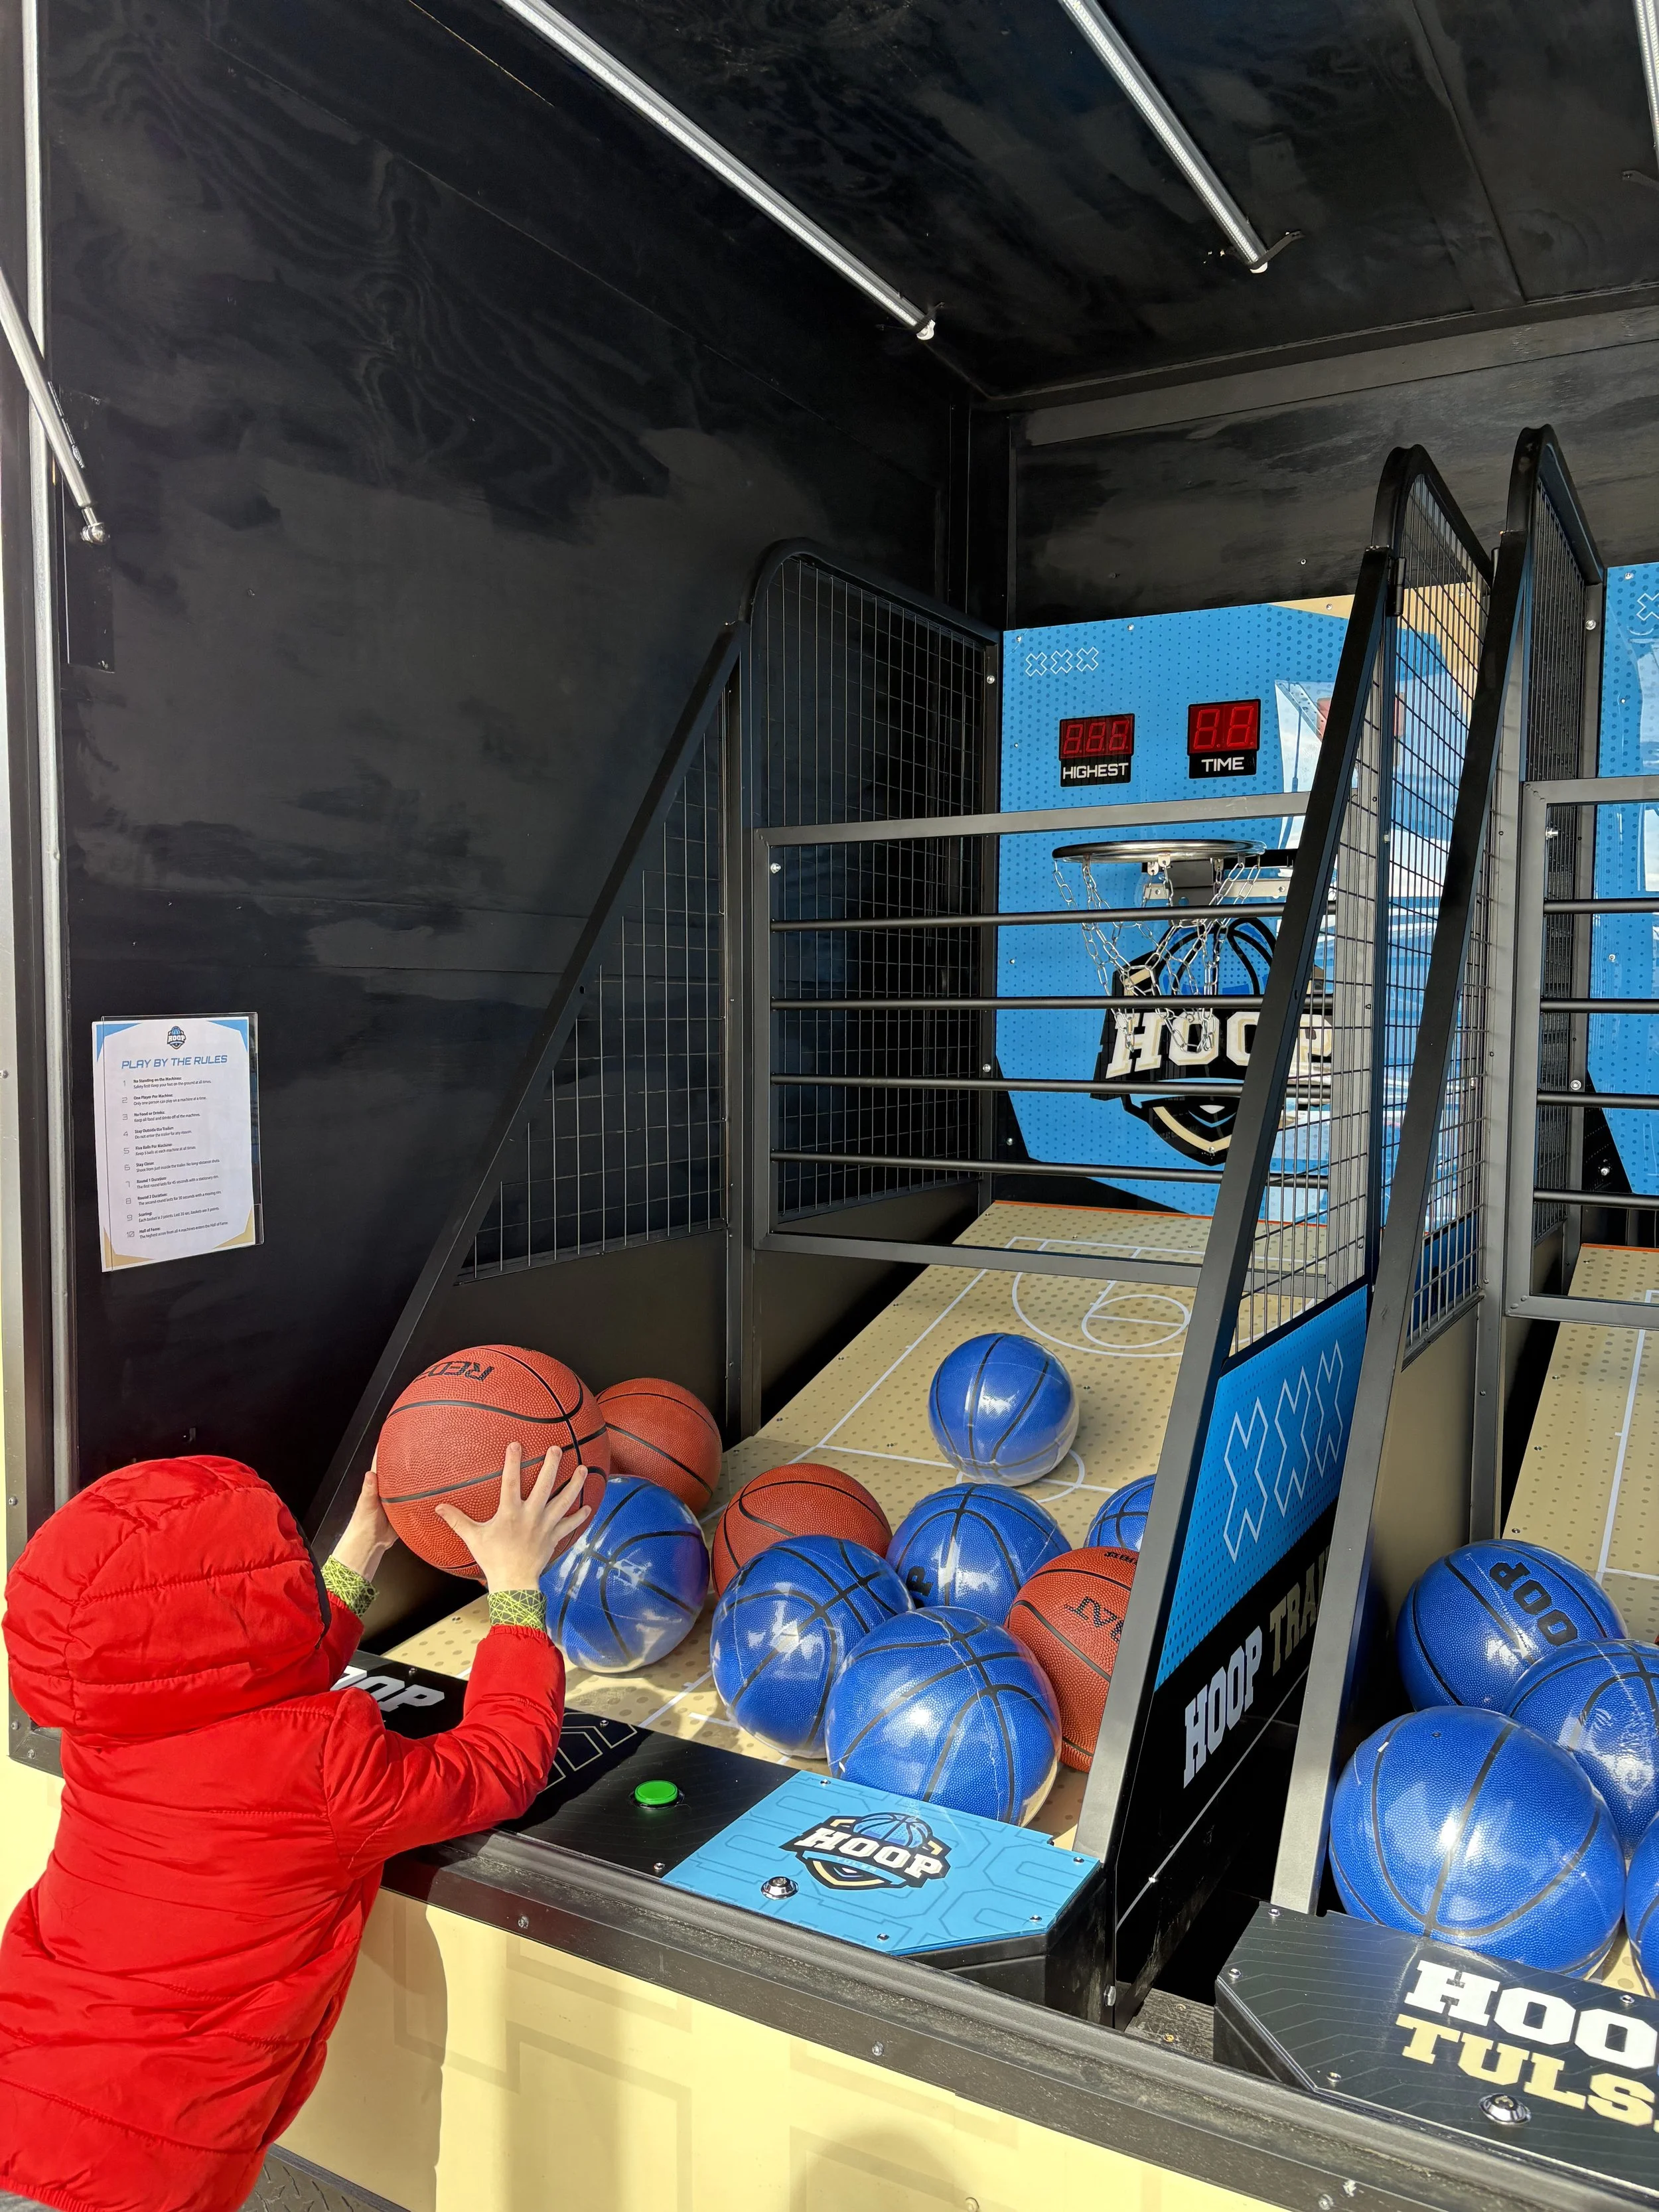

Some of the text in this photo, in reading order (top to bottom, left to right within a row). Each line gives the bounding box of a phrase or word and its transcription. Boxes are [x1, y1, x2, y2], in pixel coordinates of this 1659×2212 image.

[1062, 763, 1129, 779] HIGHEST
[1202, 757, 1244, 773] TIME
[121, 1055, 227, 1069] PLAY BY THE RULES
[1184, 1625, 1262, 1789] HOOP
[794, 1828, 944, 1878] HOOP
[836, 1857, 877, 1872] TULSA
[1404, 1960, 1659, 2069] HOO
[1396, 2014, 1659, 2133] TULS
